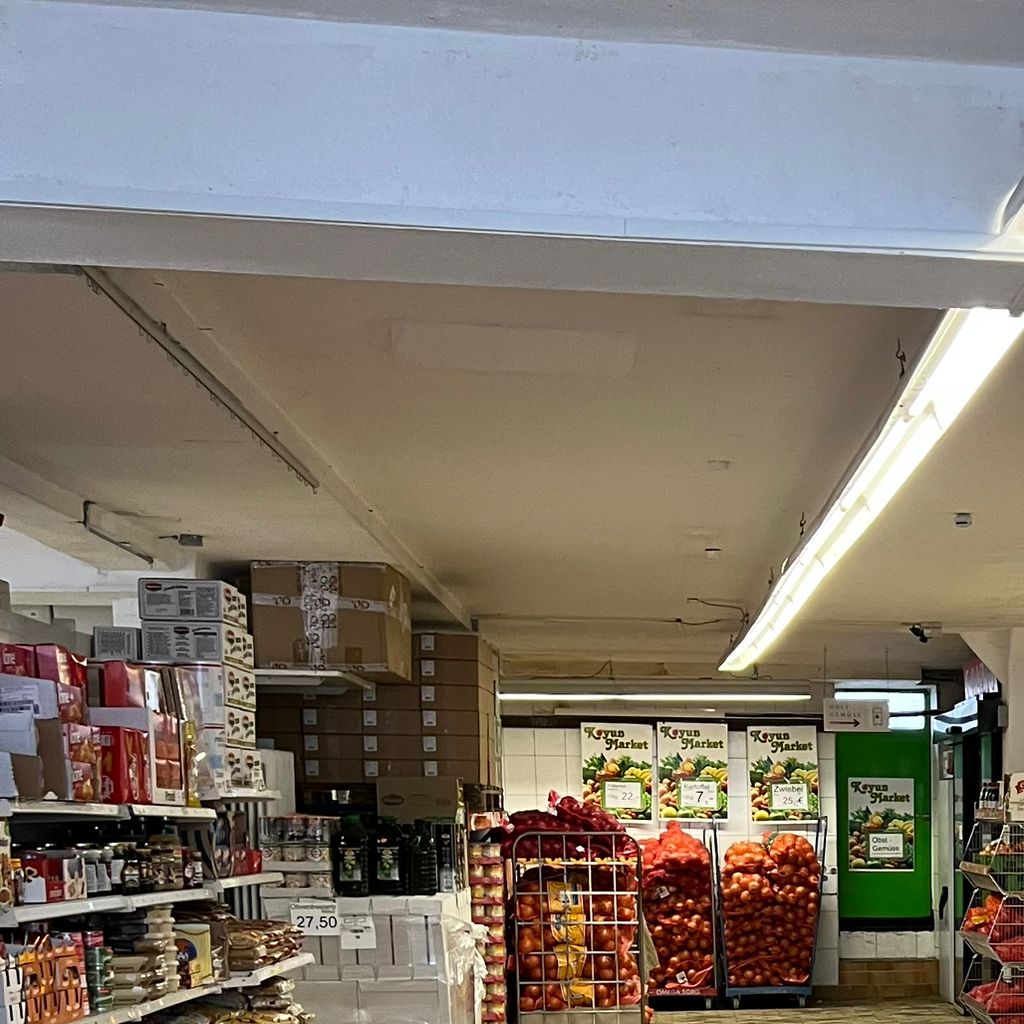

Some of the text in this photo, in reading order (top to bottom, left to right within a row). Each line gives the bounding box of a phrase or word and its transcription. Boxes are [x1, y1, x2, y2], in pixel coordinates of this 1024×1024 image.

[584, 727, 625, 740] Koyun
[660, 726, 700, 739] Koyun
[750, 730, 790, 743] Koyun
[605, 739, 648, 751] Market
[681, 738, 724, 750] Market
[771, 741, 813, 753] Market
[773, 785, 804, 793] Zwiebel
[851, 781, 889, 794] Koyun
[870, 792, 911, 804] Market
[296, 916, 338, 930] 27,50
